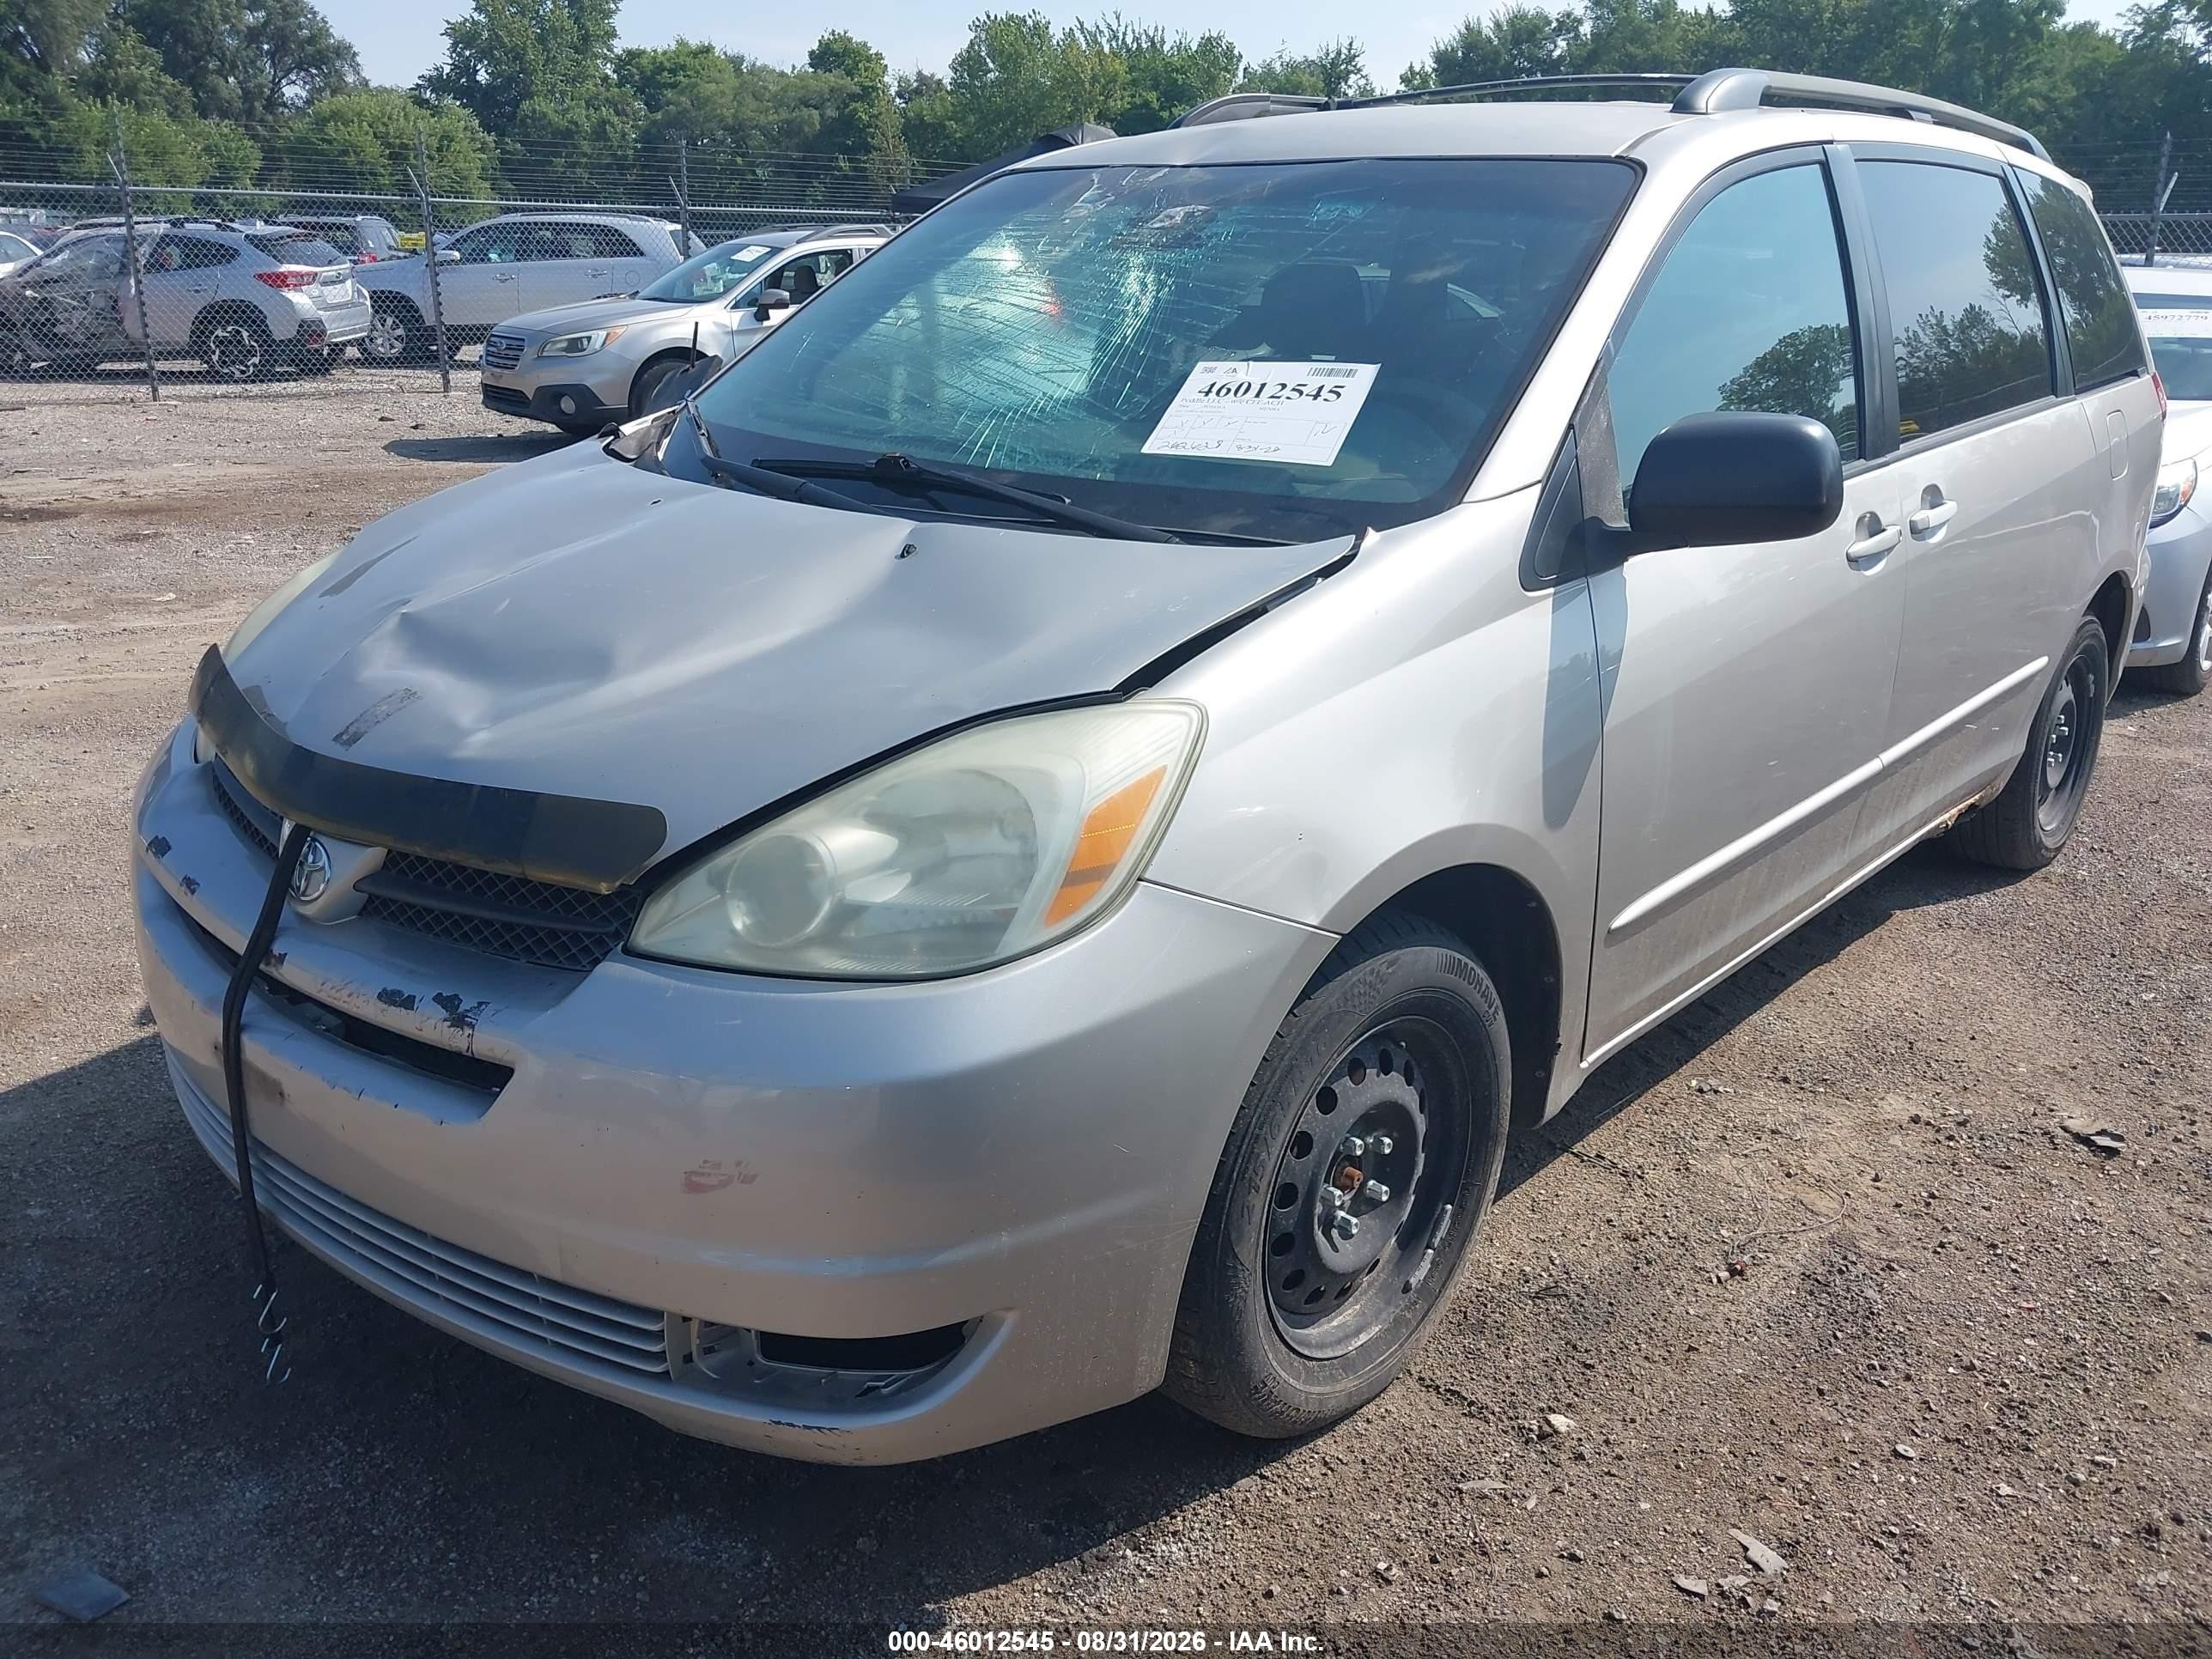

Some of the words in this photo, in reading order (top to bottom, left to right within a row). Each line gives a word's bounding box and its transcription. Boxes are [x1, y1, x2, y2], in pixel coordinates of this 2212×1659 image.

[1197, 380, 1346, 403] 46012545
[1454, 957, 1500, 1023] MOHAVE
[1482, 1009, 1496, 1029] CUV
